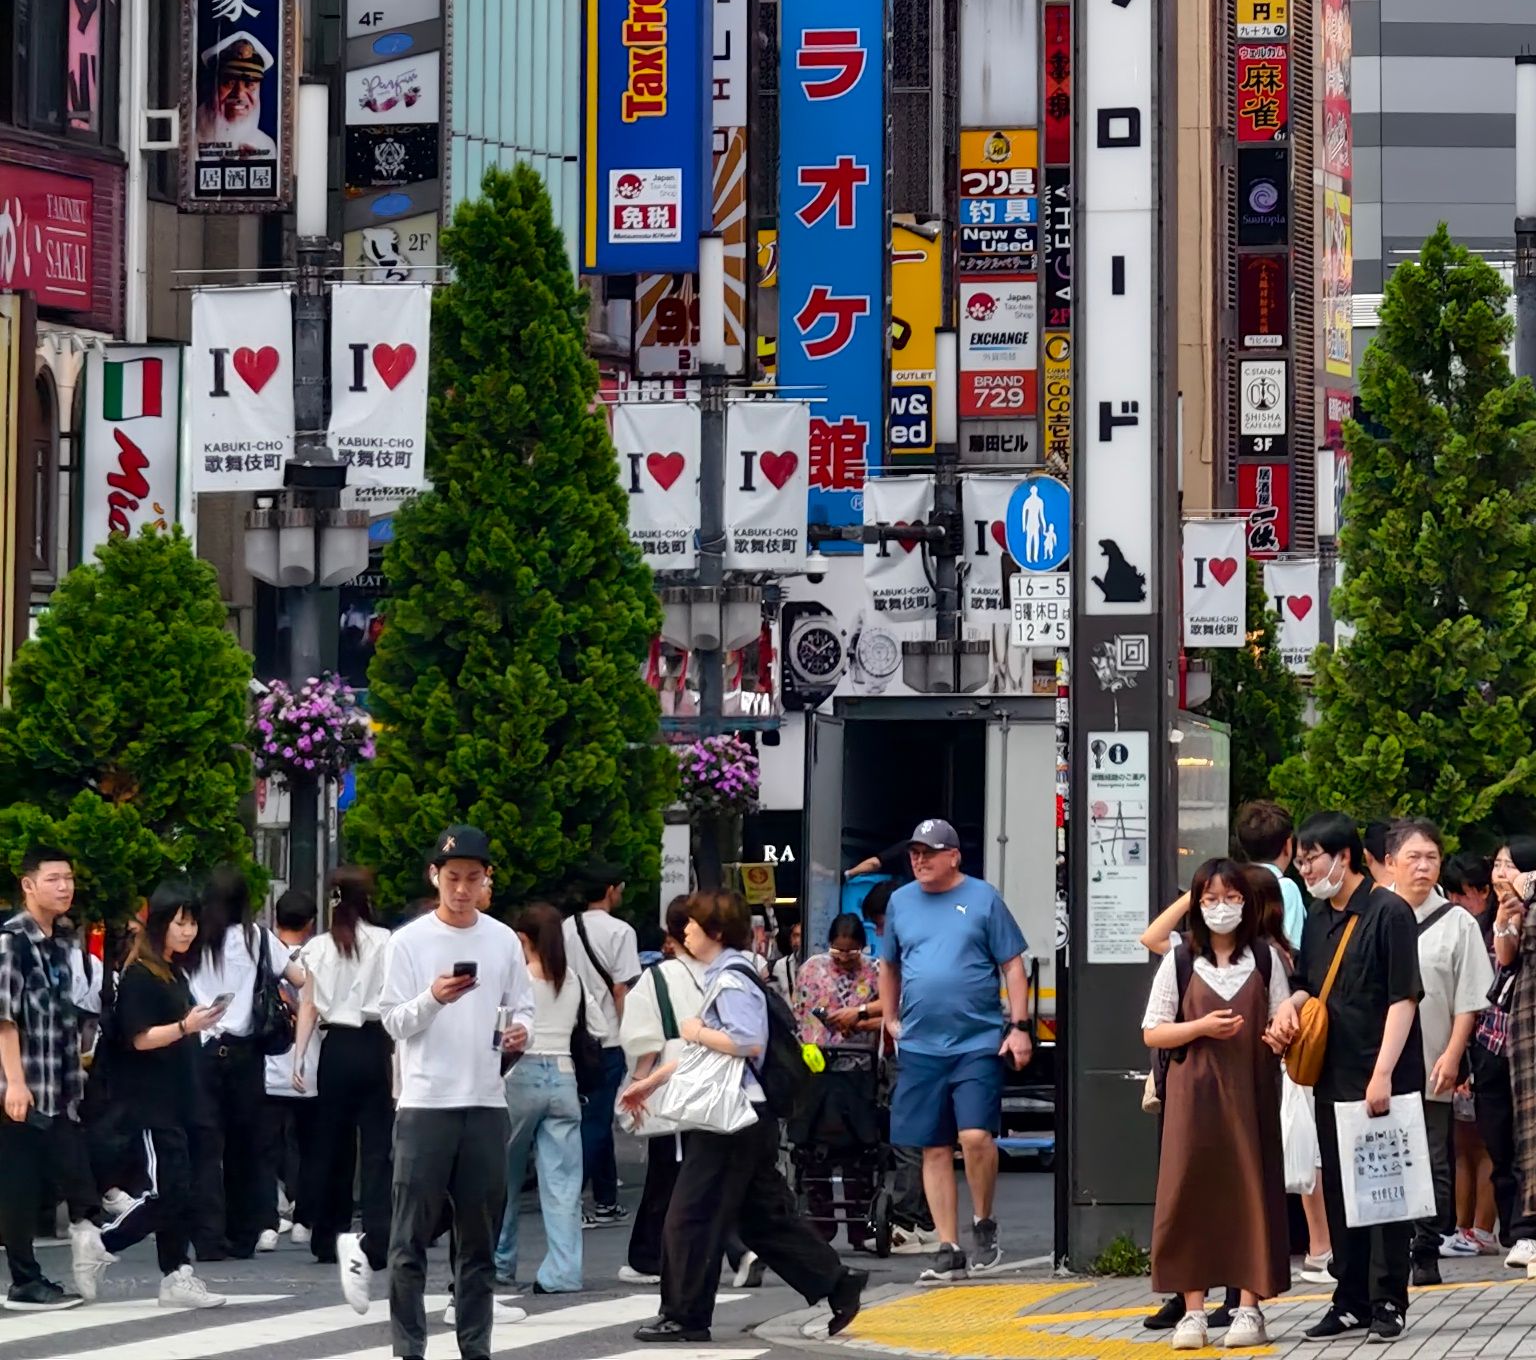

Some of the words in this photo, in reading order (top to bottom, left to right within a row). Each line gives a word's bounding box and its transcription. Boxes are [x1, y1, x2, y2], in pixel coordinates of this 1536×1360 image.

[358, 11, 385, 27] 4F
[1239, 62, 1285, 131] 麻雀
[962, 168, 1036, 195] つり具
[620, 206, 670, 229] 免税
[963, 228, 1009, 241] New
[1014, 228, 1028, 240] &
[408, 233, 432, 253] 2F
[981, 239, 1034, 252] Used
[46, 239, 87, 283] SAKAI
[1006, 293, 1032, 302] Japan
[970, 331, 1030, 346] EXCHANGE
[209, 348, 231, 398] I
[348, 342, 368, 392] I
[896, 372, 933, 381] OUTLET
[974, 375, 1024, 387] BRAND
[974, 388, 1024, 408] 729
[1244, 413, 1281, 422] SHISHA
[204, 440, 284, 453] KABUKI-CHO
[338, 435, 415, 449] KABUKI-CHO
[1253, 437, 1273, 452] 3F
[204, 454, 284, 474] 歌舞伎町
[338, 450, 414, 470] 歌舞伎町
[734, 528, 798, 538] KABUKI-CHO
[734, 538, 797, 554] 歌舞伎町
[873, 586, 931, 597] KABUKI-CHO
[874, 596, 930, 611] 歌舞伎町
[1189, 624, 1238, 636] 歌舞伎町
[763, 843, 796, 863] RA
